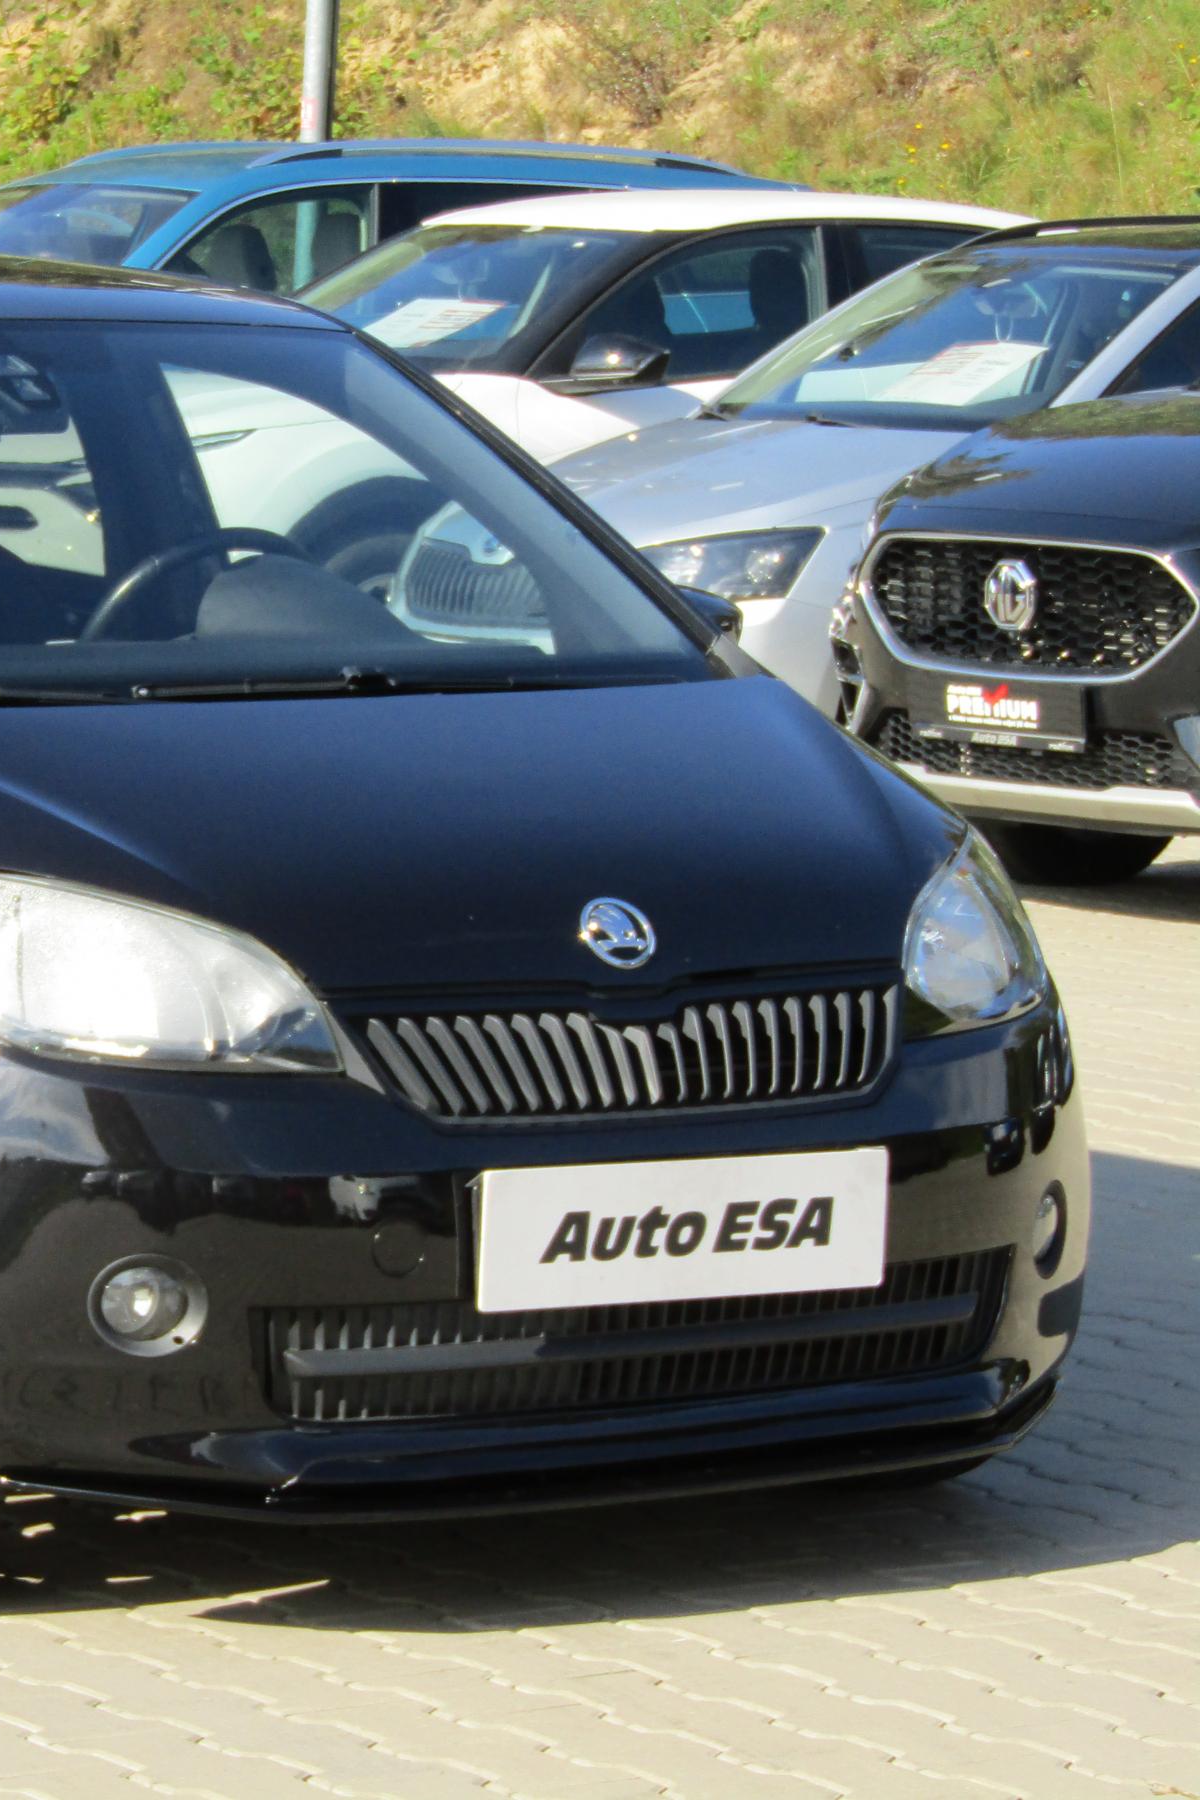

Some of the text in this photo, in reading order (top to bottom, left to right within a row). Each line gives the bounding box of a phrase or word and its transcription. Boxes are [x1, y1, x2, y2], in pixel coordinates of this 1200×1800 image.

[987, 563, 1030, 625] MG
[946, 694, 1038, 720] PREMIUM
[539, 1196, 834, 1264] Auto ESA
